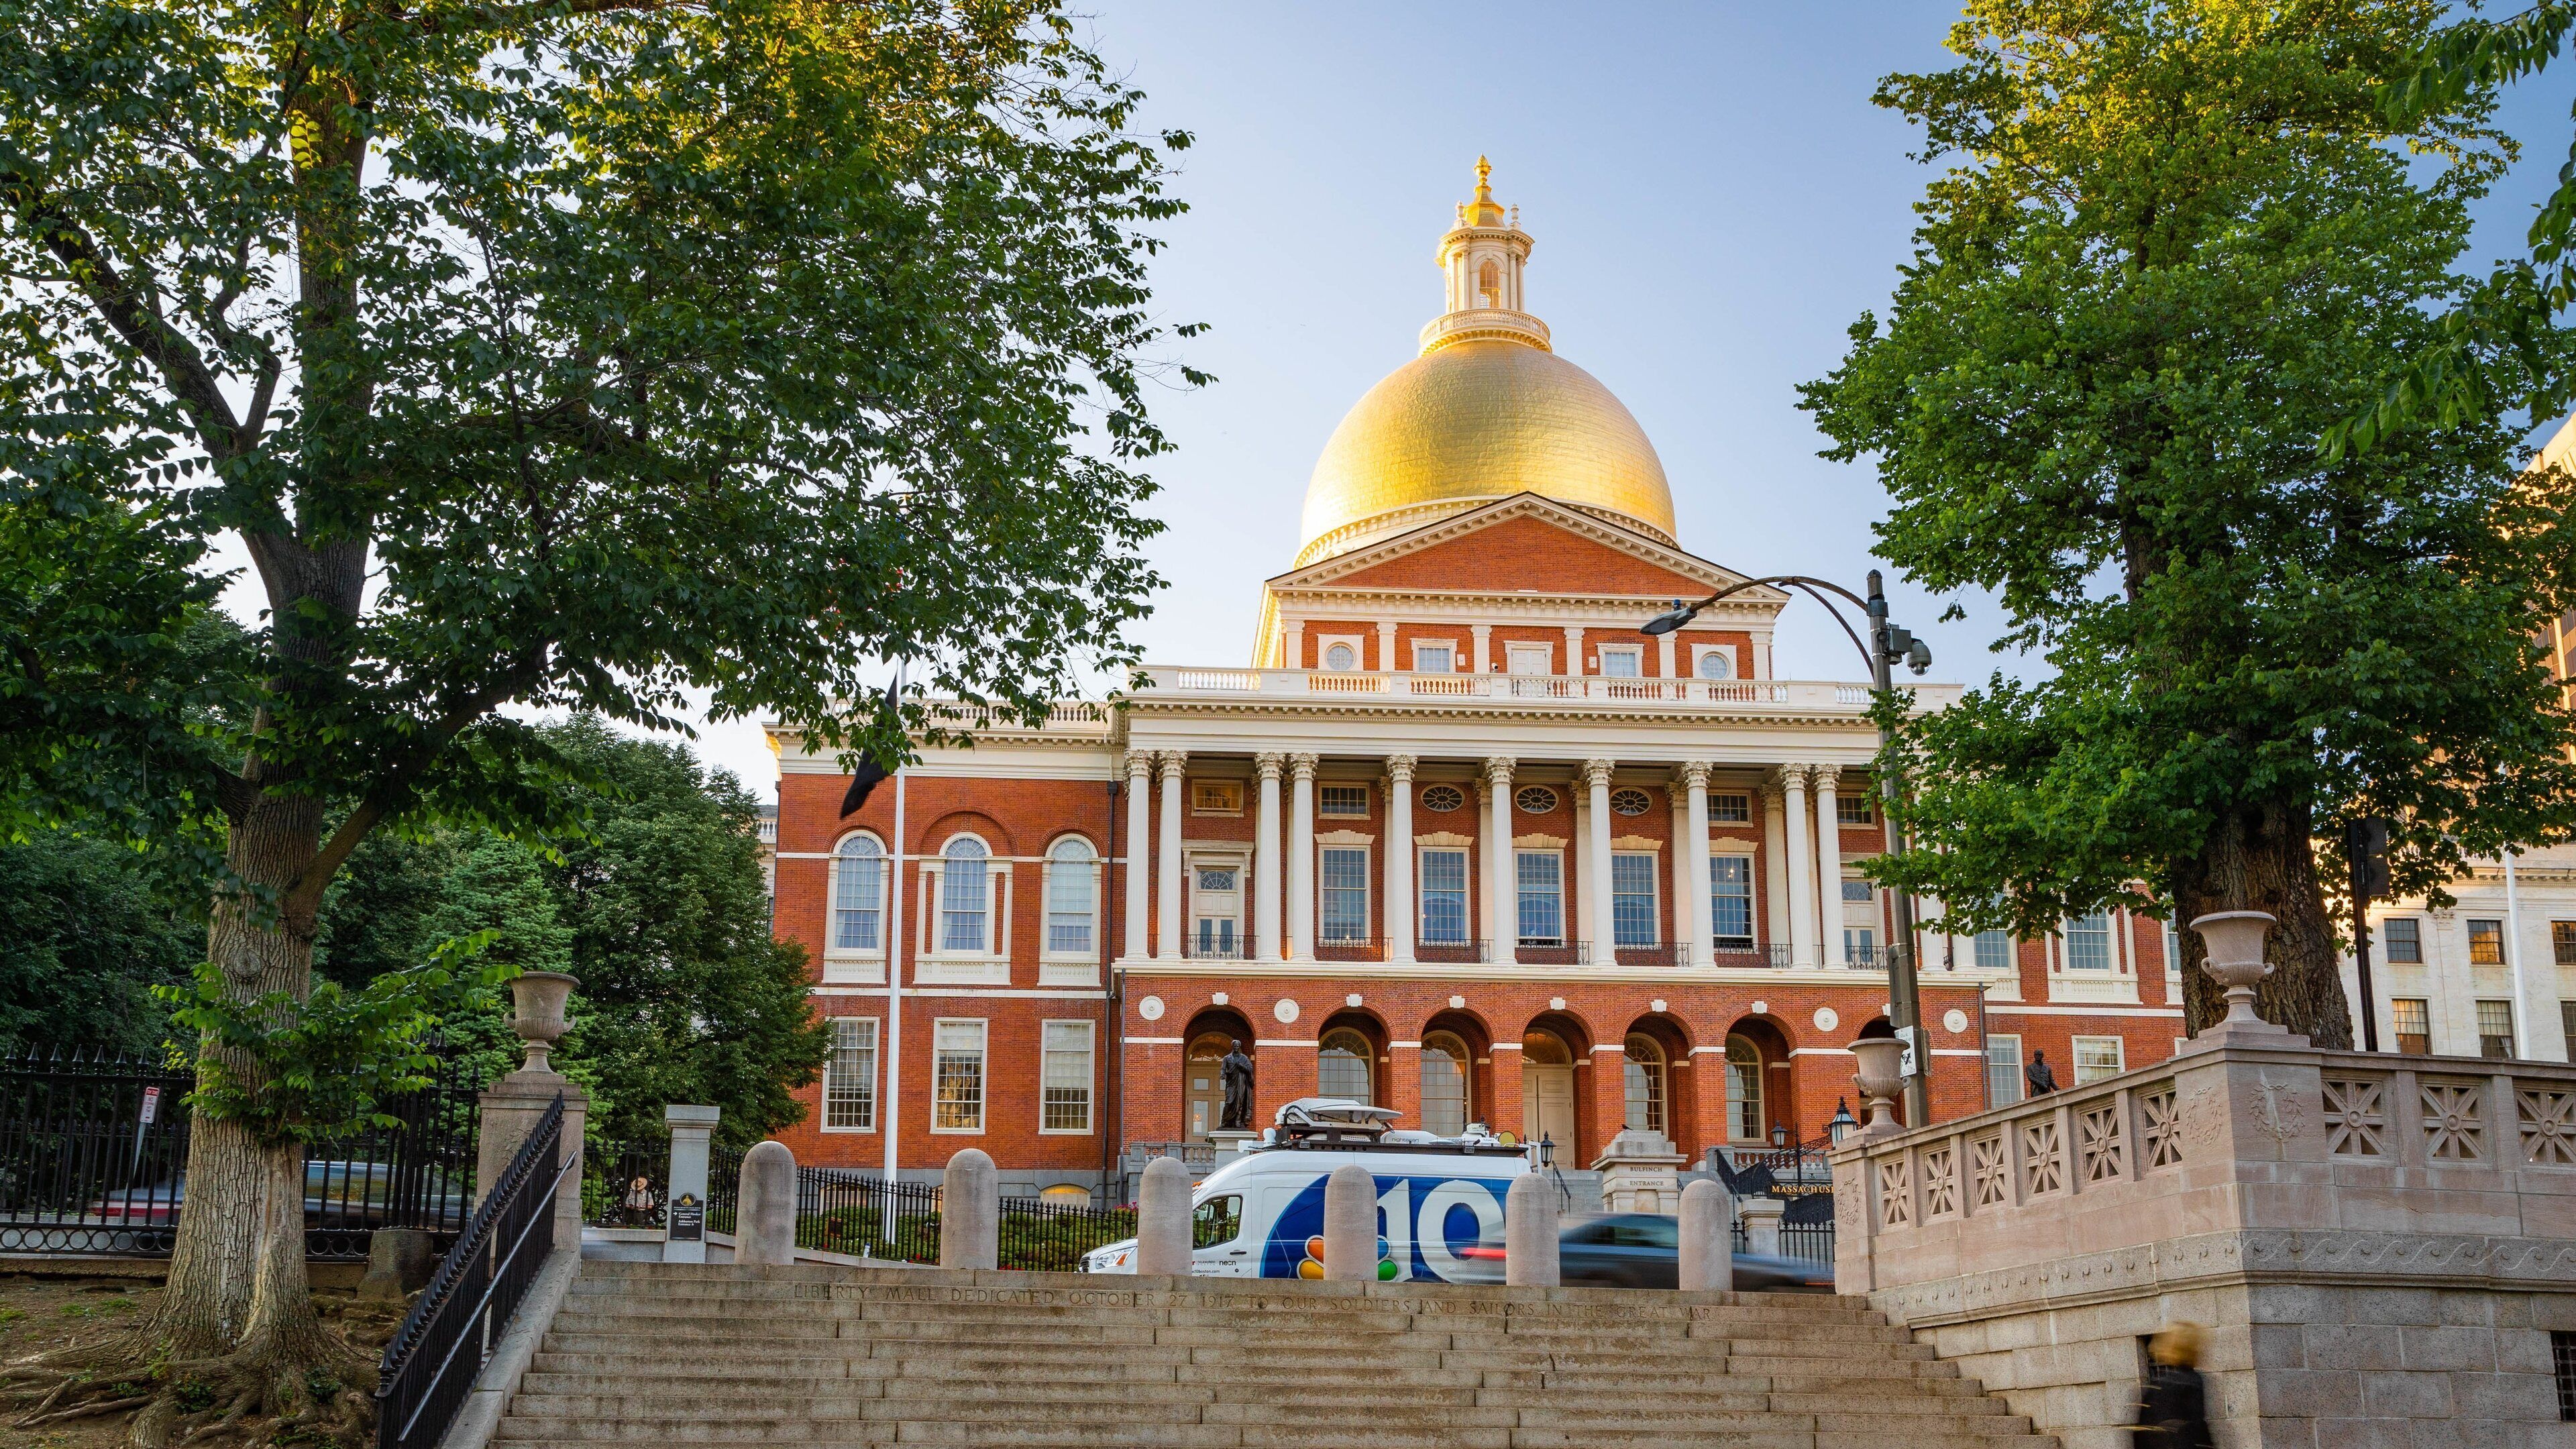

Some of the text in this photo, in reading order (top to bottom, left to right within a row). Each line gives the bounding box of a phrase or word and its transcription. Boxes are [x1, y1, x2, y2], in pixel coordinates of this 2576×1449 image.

[1377, 1179, 1506, 1284] 10
[794, 1284, 1711, 1320] LIBERTY MALL DEDICATED OCTOBER 27 1917 TO OUR SOLDIERS AND SAILORS IN THE GREAT WAR
